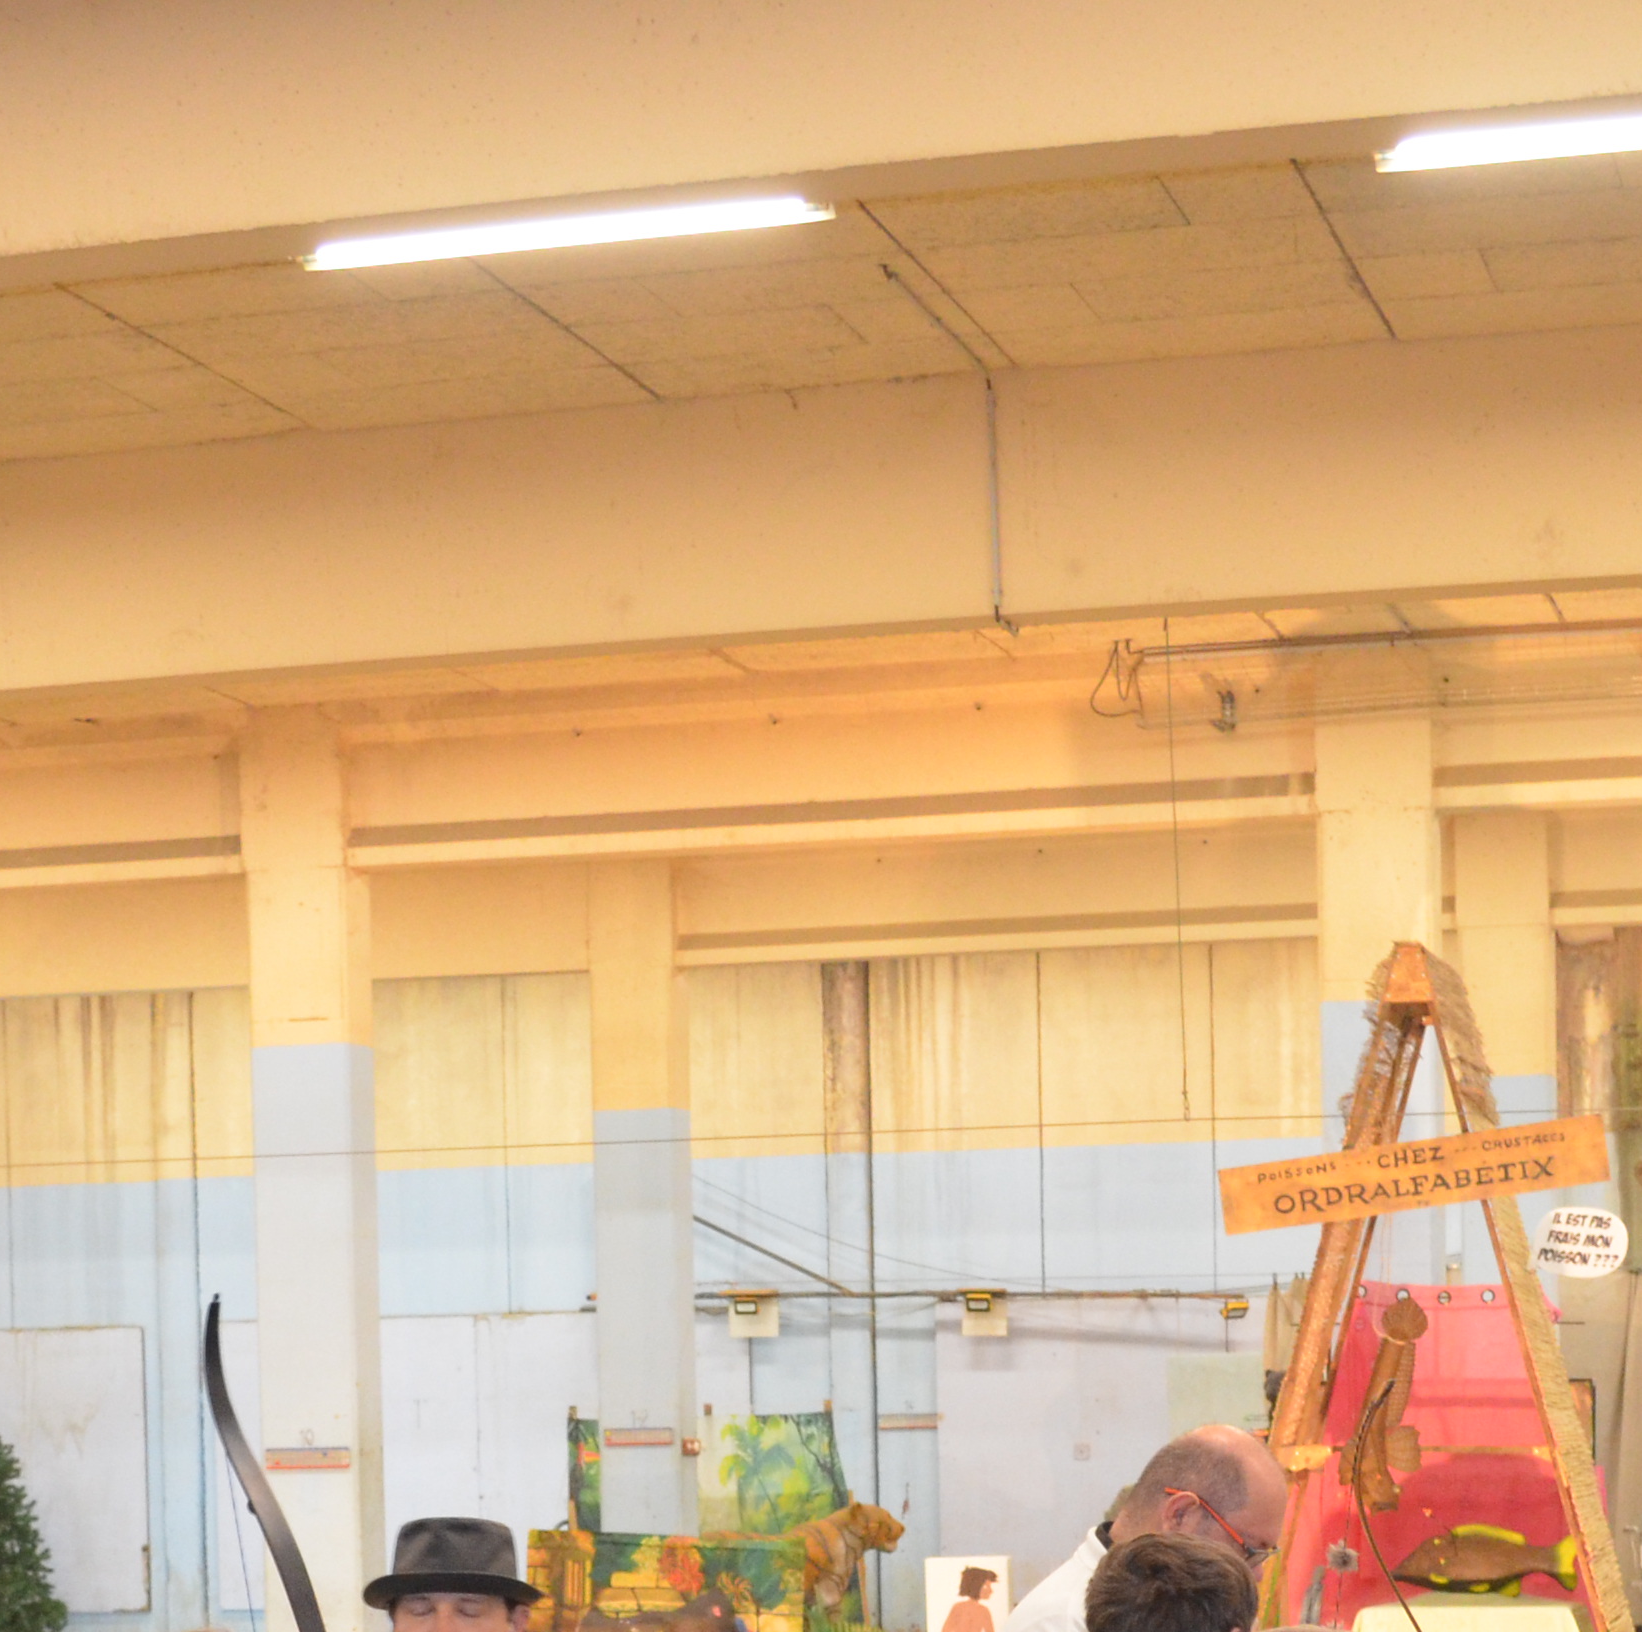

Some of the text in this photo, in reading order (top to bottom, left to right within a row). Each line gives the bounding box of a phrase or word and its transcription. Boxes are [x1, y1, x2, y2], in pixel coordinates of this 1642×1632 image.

[1377, 1146, 1445, 1169] CHEZ
[1565, 1213, 1588, 1227] EST
[1589, 1214, 1612, 1230] PAS
[1547, 1229, 1613, 1249] FRAIS MON
[1537, 1247, 1590, 1266] POISSON
